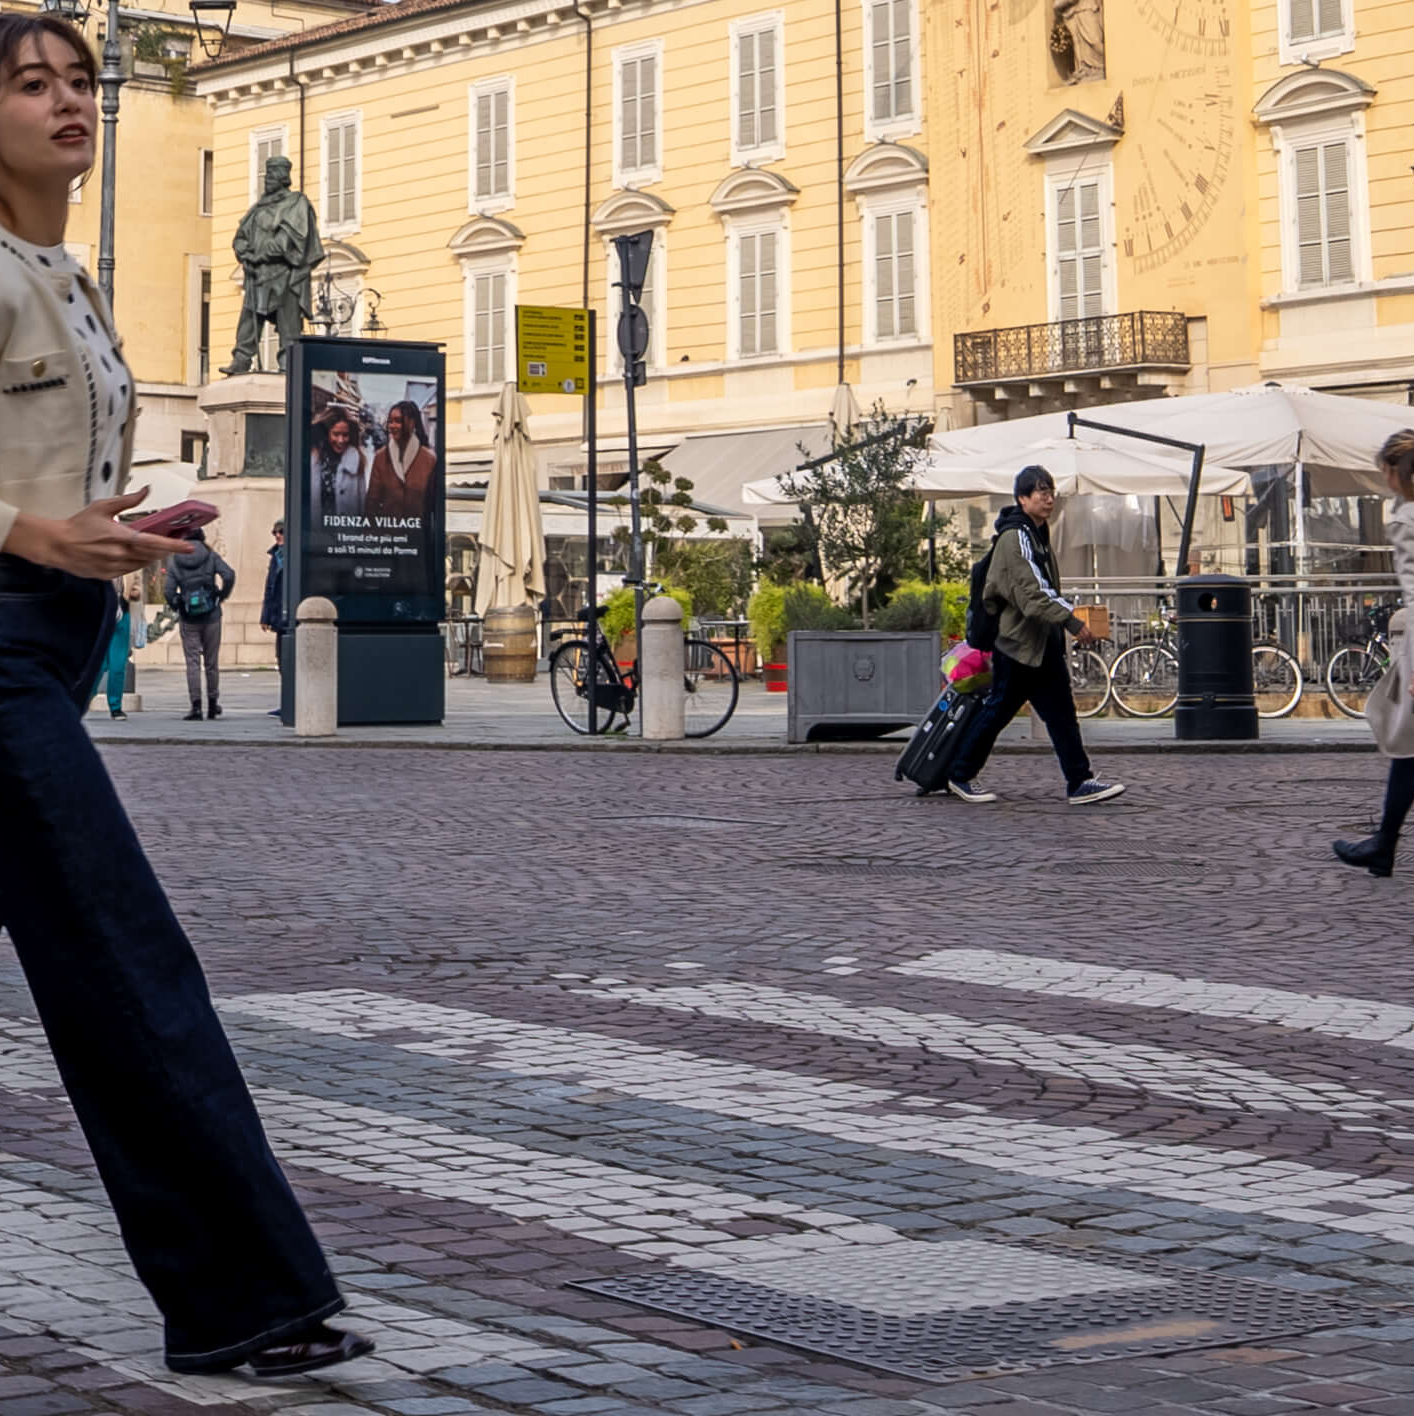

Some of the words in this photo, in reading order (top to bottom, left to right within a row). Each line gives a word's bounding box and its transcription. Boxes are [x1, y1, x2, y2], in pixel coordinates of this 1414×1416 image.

[323, 515, 371, 527] FIDENZA
[375, 516, 422, 528] VILLAGE
[342, 533, 364, 542] brand
[365, 533, 378, 542] che
[393, 534, 408, 543] ami
[334, 545, 347, 554] soli
[357, 545, 381, 554] minuti
[383, 546, 392, 554] da
[394, 546, 418, 555] Parma
